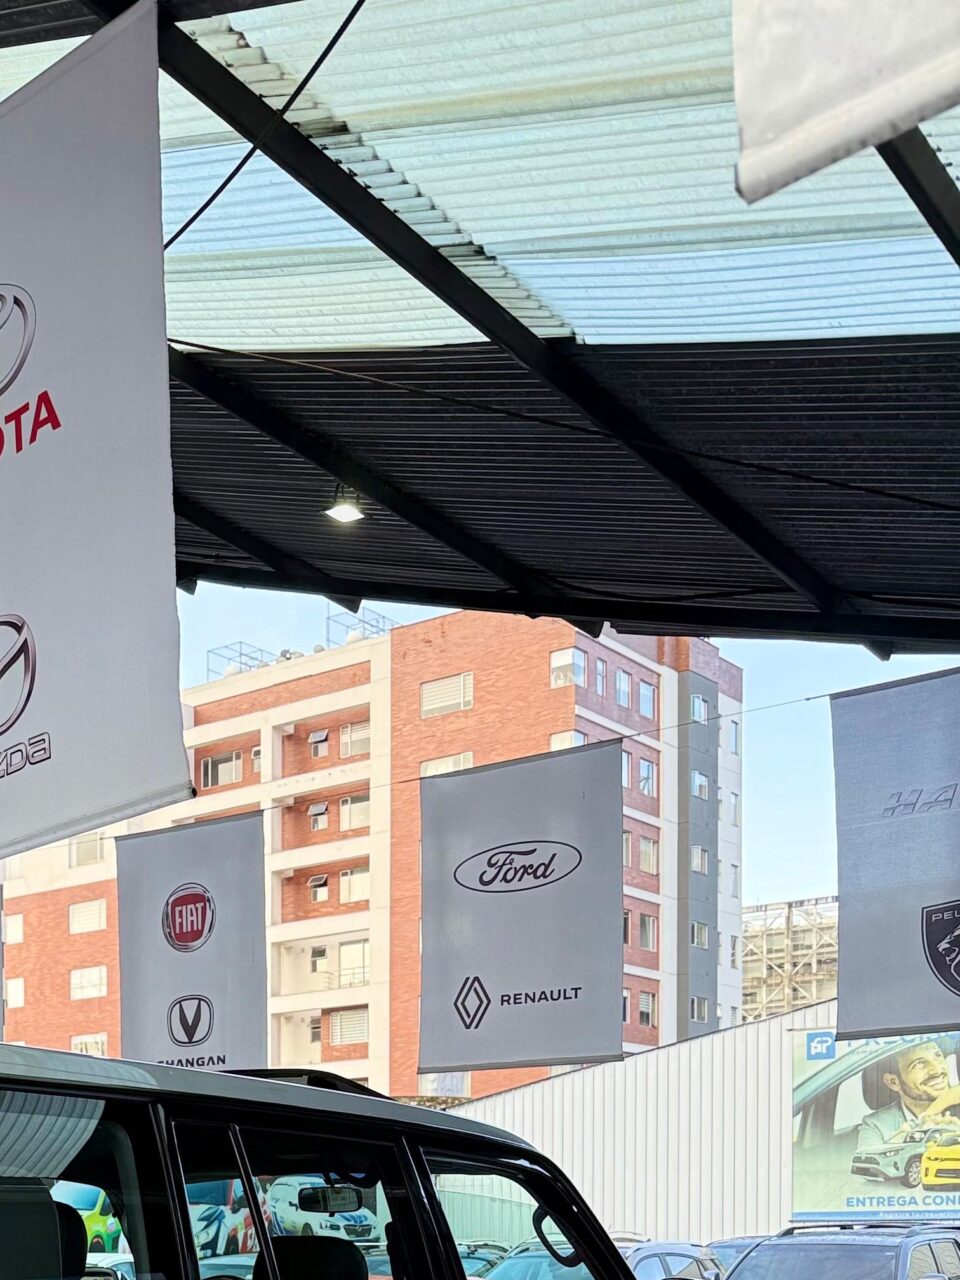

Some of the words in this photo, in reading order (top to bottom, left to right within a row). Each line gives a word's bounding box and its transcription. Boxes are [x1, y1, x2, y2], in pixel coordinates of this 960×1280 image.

[479, 848, 557, 886] Ford
[175, 902, 205, 934] FIAT
[500, 987, 582, 1006] RENAULT
[846, 1196, 918, 1207] ENTREGA
[922, 1195, 960, 1206] CON
